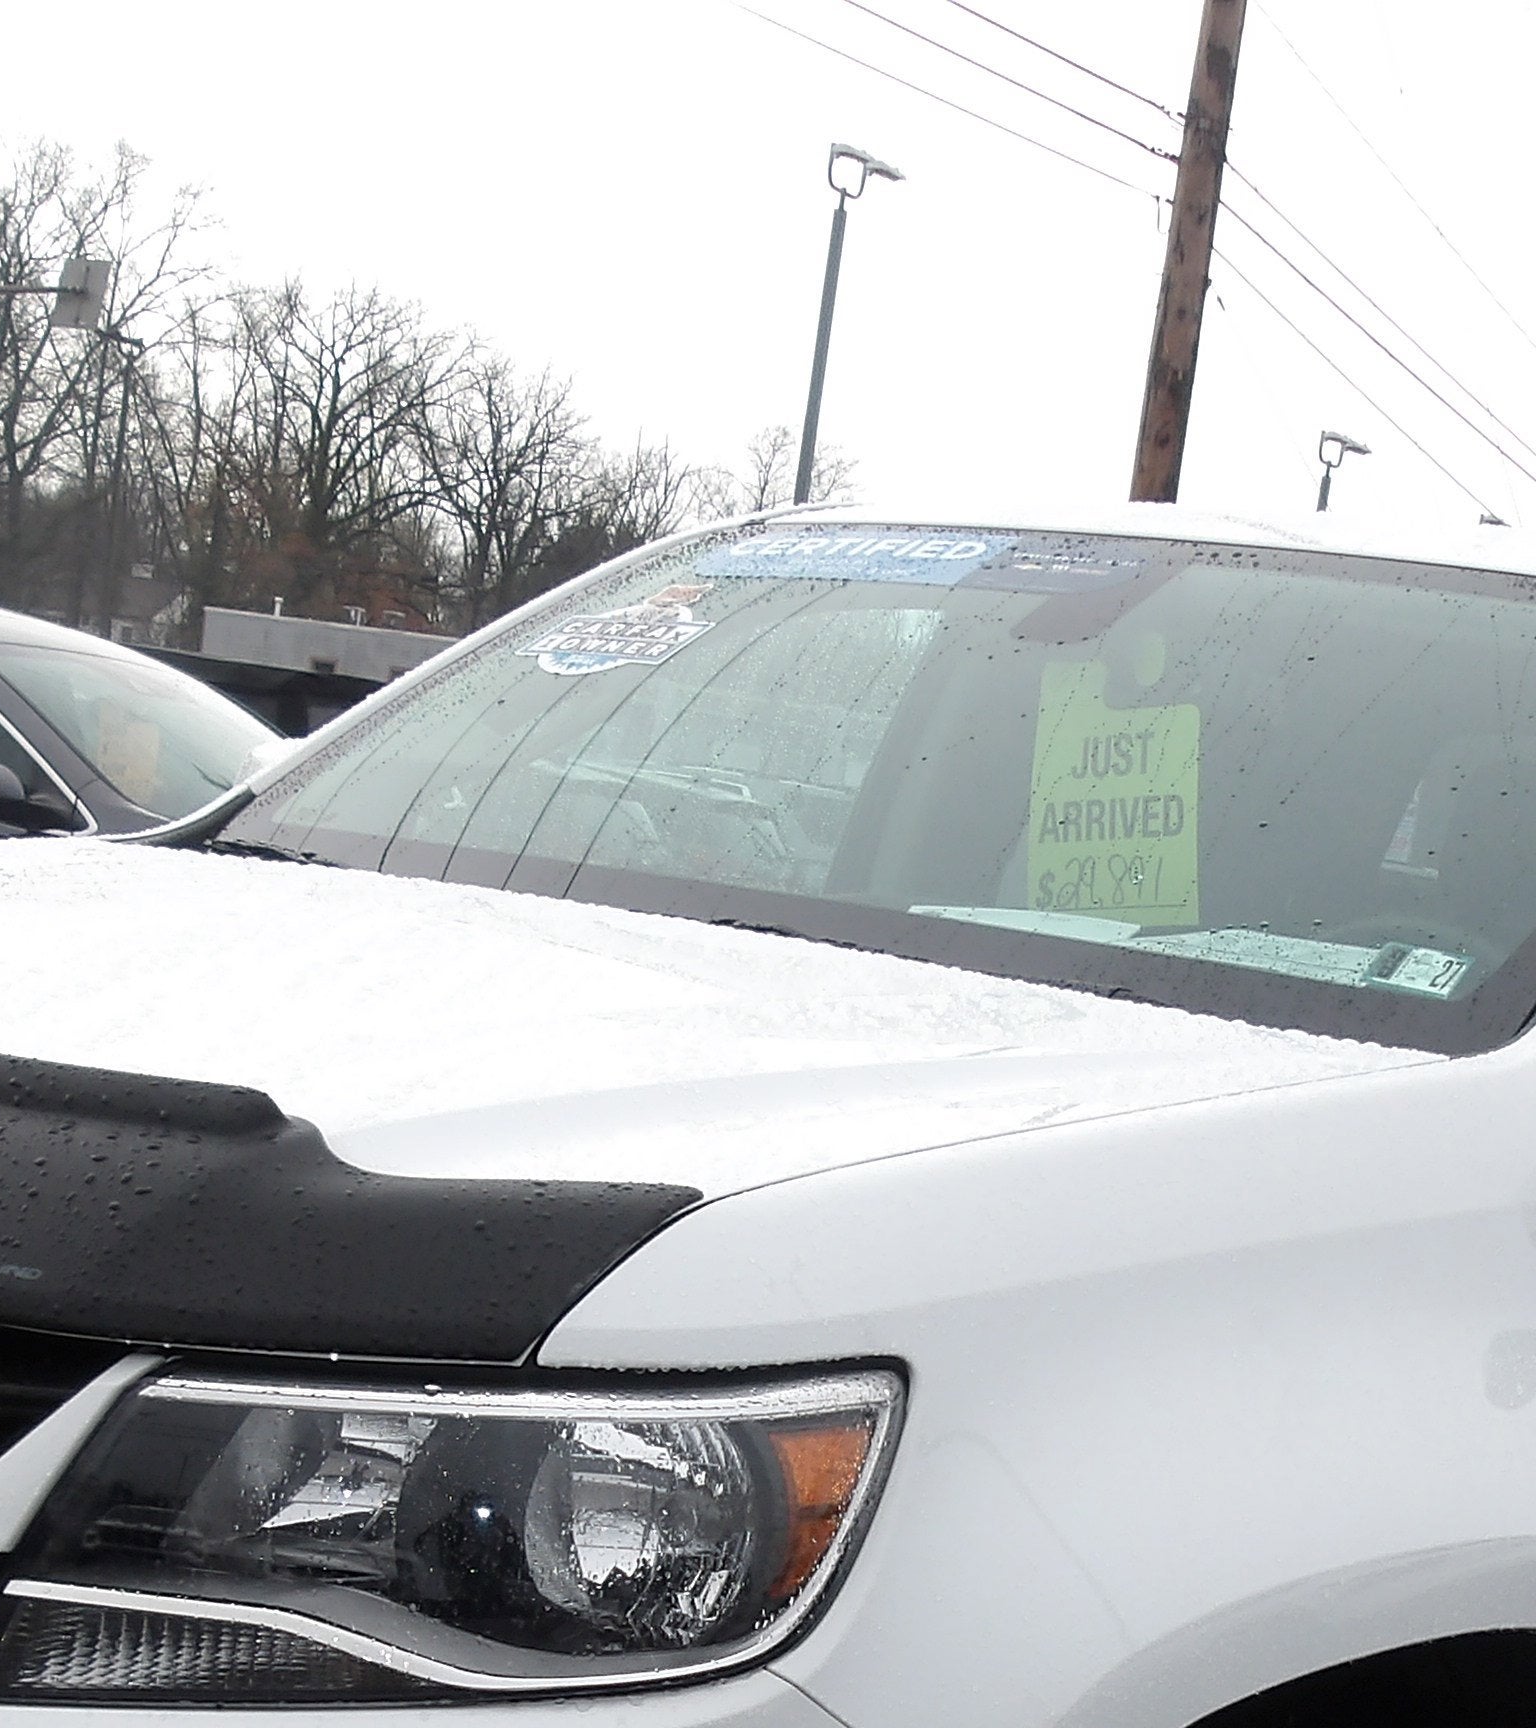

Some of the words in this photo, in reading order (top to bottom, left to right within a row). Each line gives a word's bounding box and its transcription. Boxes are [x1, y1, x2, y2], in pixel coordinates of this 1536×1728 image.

[731, 537, 988, 560] CERTIFIED
[563, 621, 690, 643] CARFAX
[559, 636, 669, 657] OWNER
[1071, 731, 1155, 779] JUST
[1038, 795, 1184, 843] ARRIVED
[1428, 959, 1466, 990] 27
